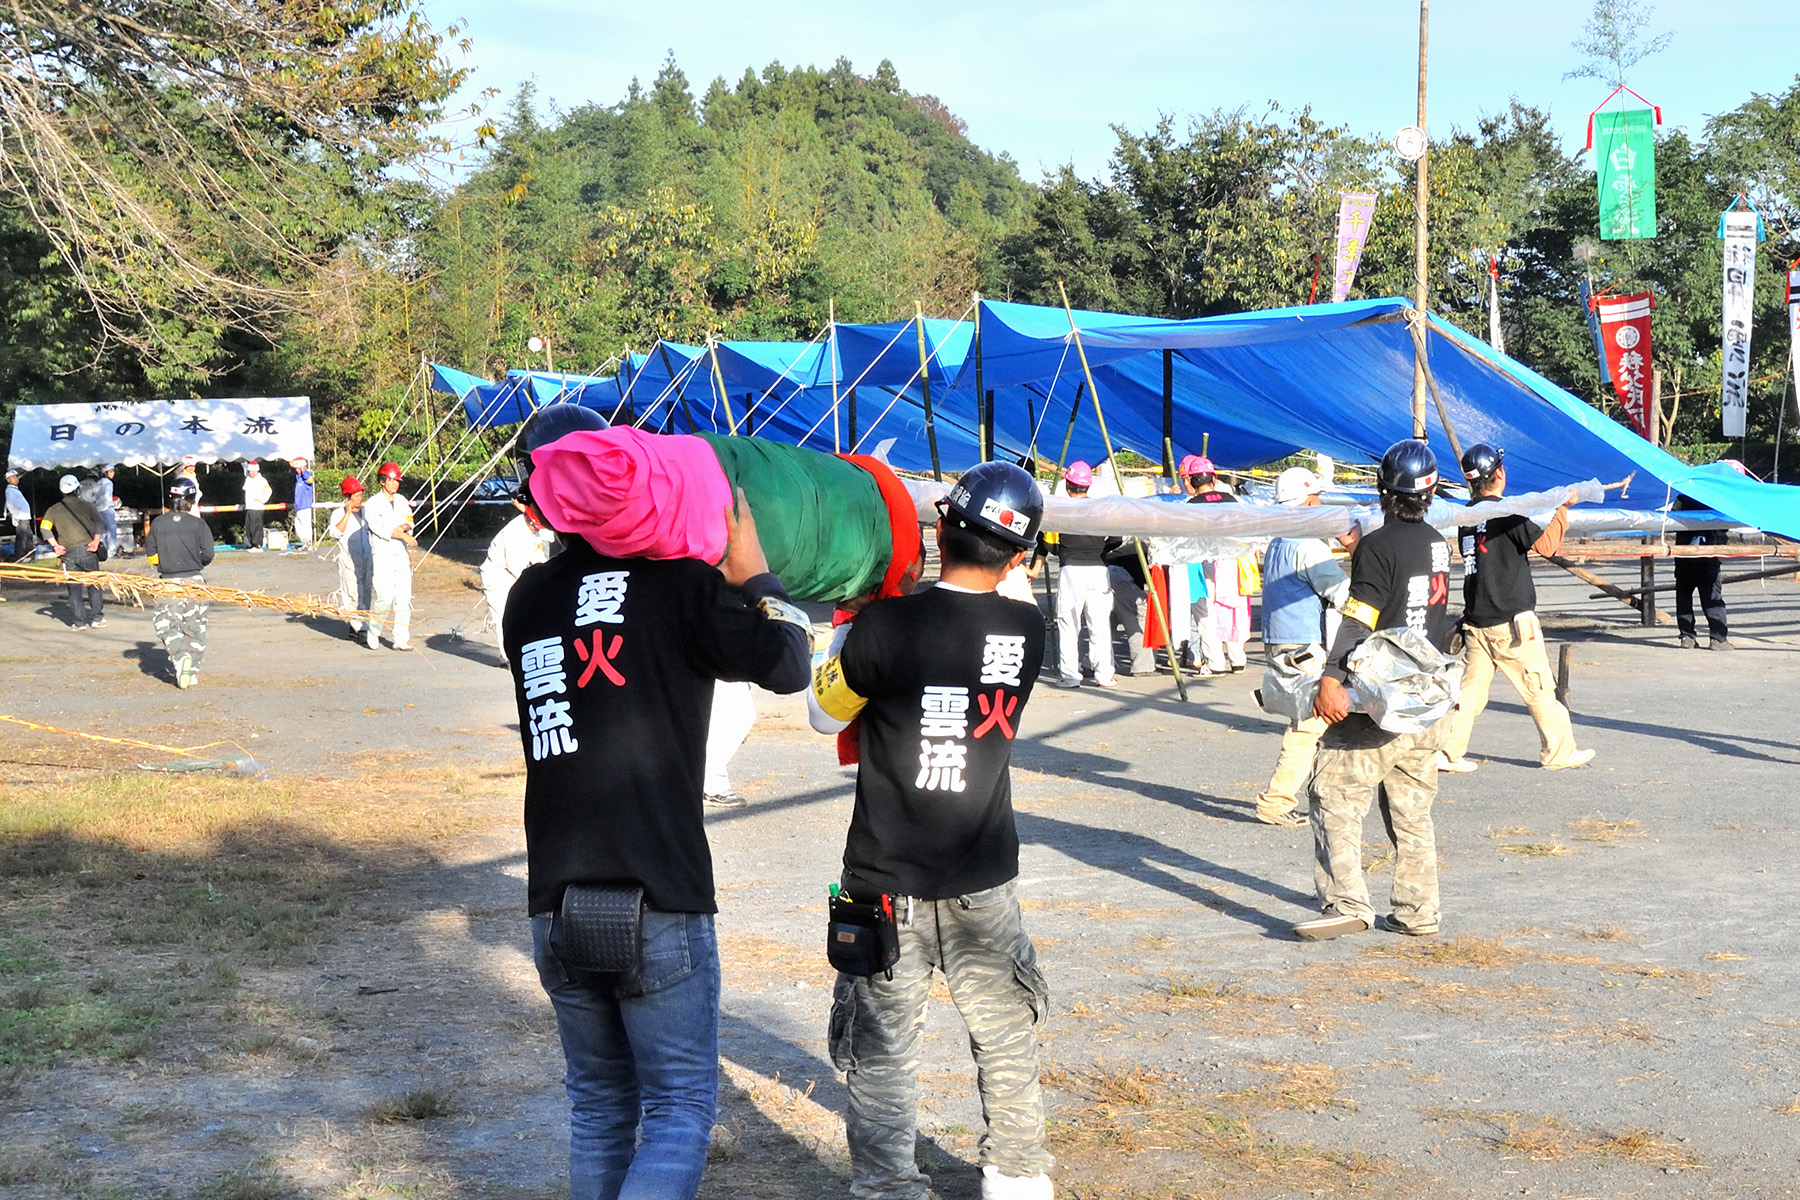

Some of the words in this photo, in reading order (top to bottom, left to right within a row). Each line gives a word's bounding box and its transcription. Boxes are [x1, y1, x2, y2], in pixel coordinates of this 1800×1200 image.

[50, 415, 279, 441] 日の本流
[573, 570, 629, 689] 愛火
[521, 635, 579, 761] 雲流
[915, 685, 970, 793] 雲流
[973, 634, 1026, 740] 愛火
